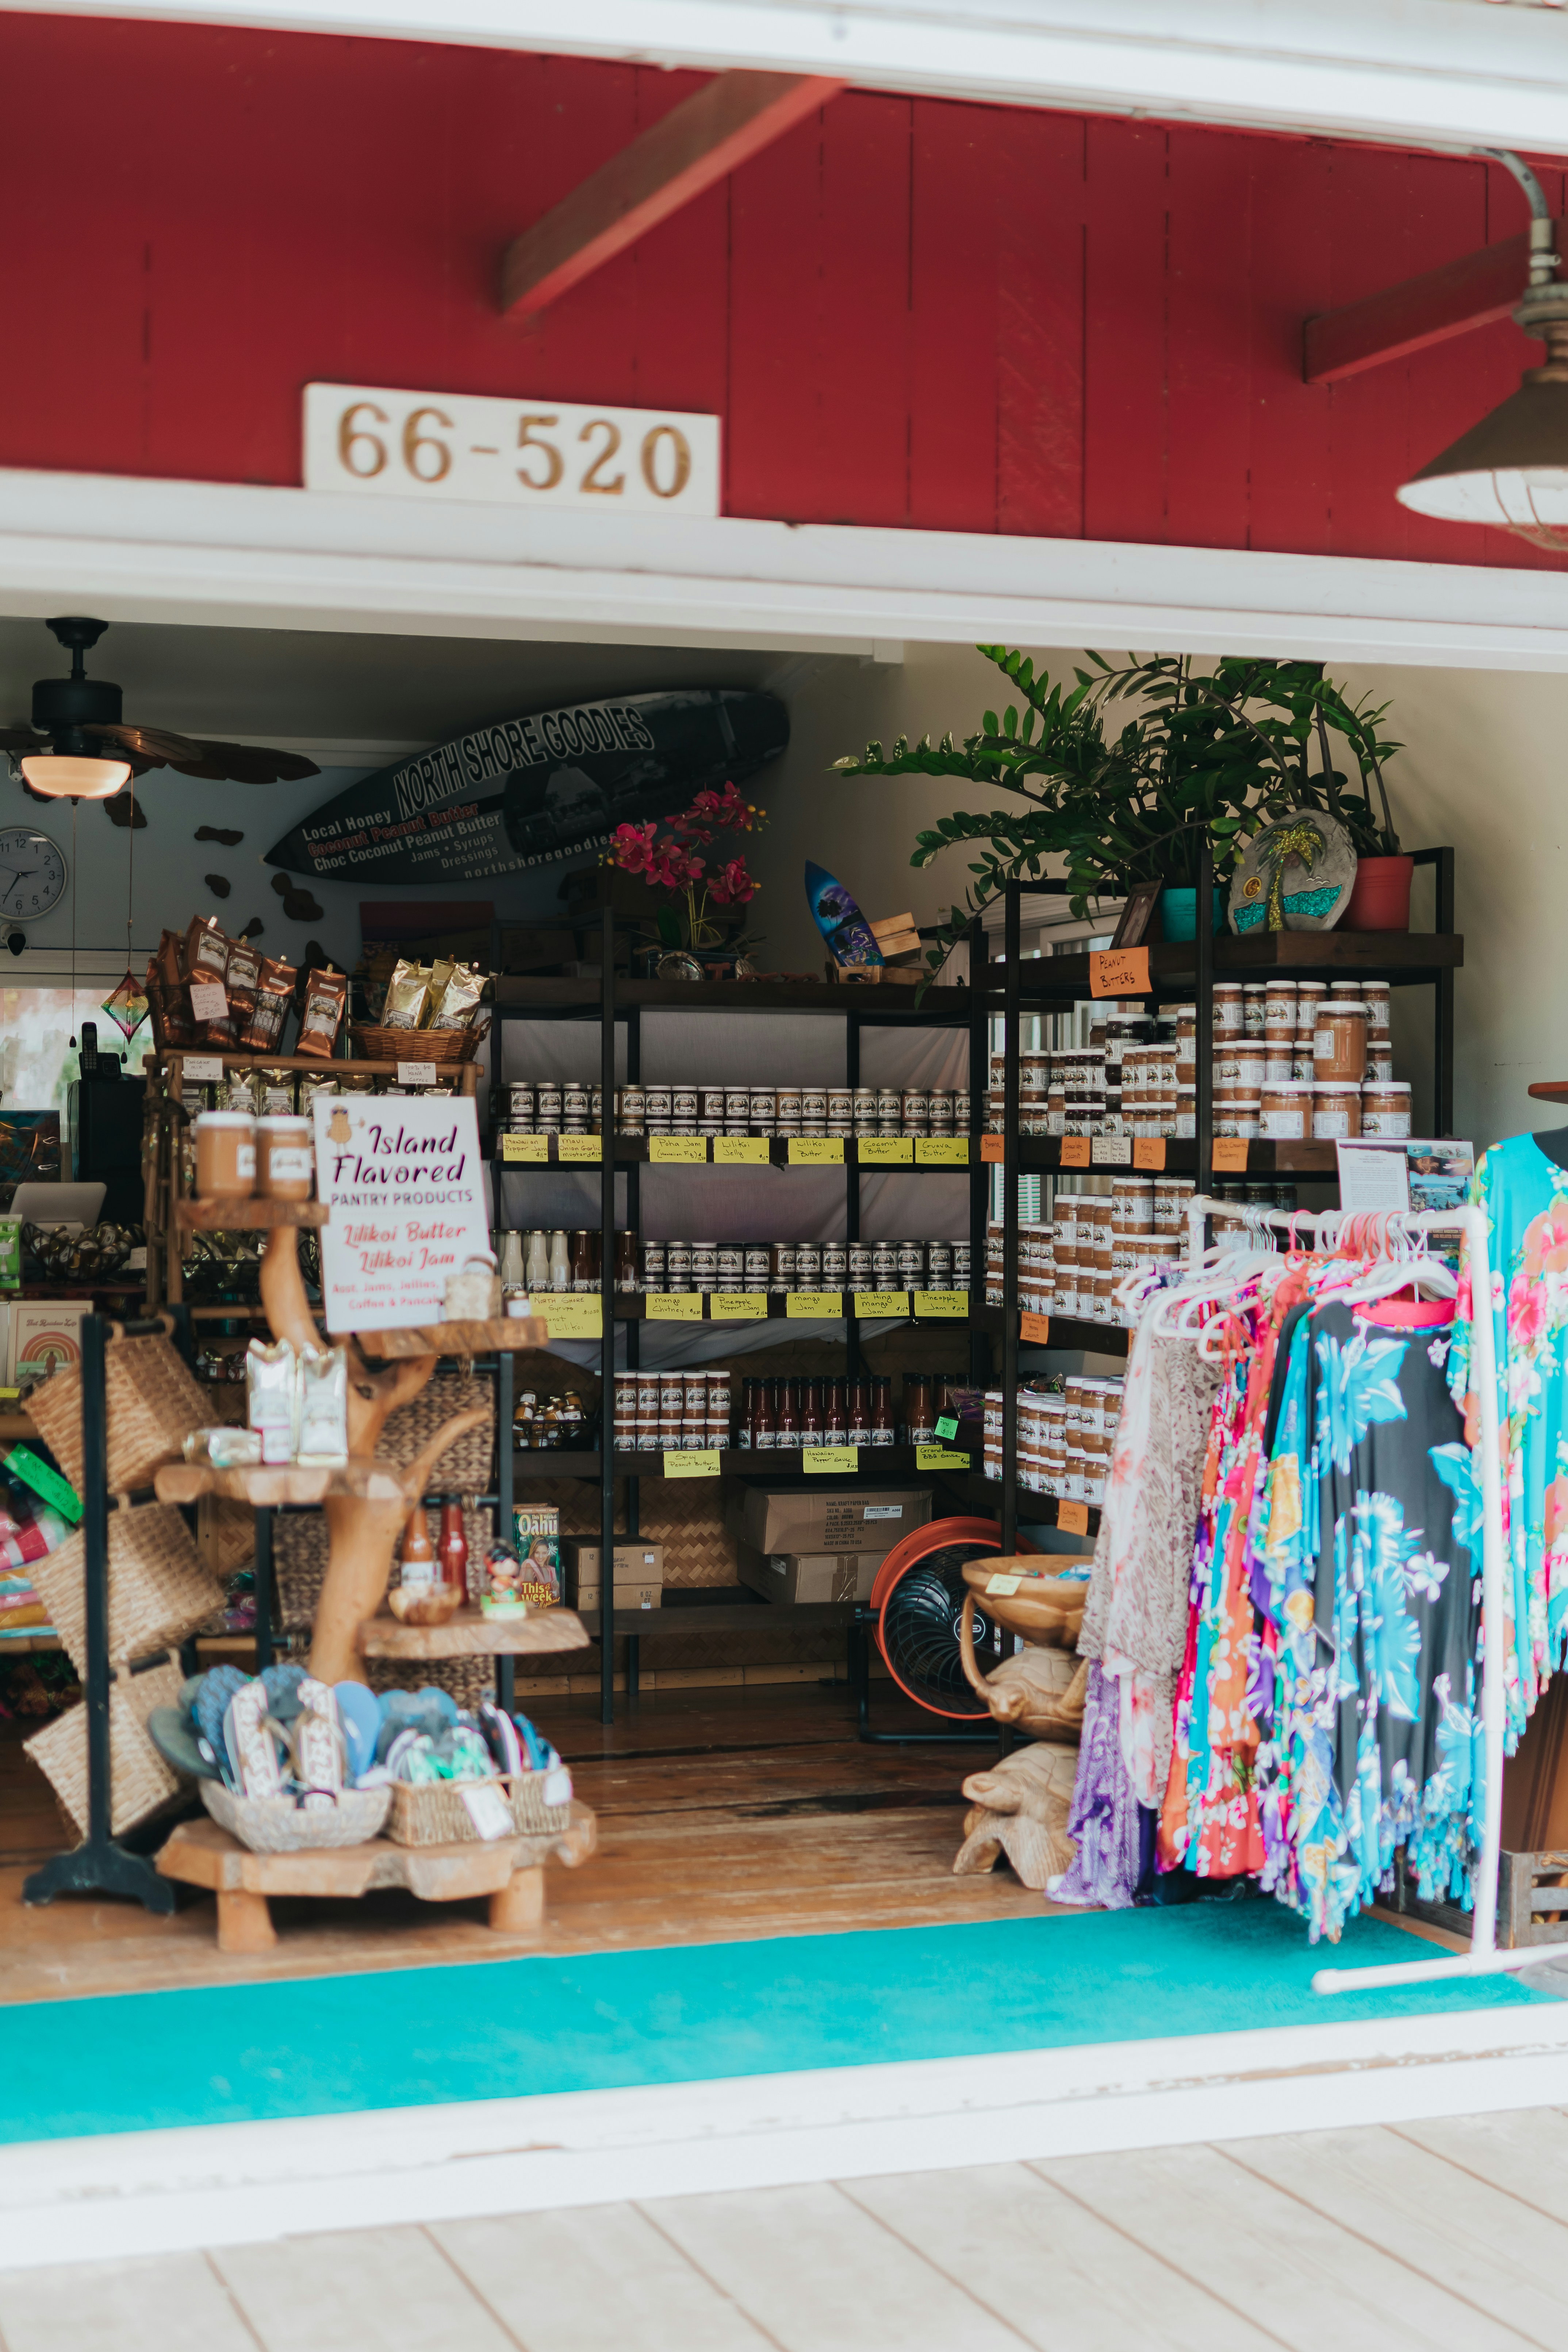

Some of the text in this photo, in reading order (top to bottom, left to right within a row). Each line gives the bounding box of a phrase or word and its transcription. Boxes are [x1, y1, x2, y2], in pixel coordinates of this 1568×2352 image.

[338, 402, 691, 499] 66-520
[393, 706, 655, 821] NORTH SHORE GOODIES
[302, 810, 391, 841] Local Honey
[307, 802, 479, 858] Coconut Peanut Butter
[0, 843, 9, 852] 11
[15, 839, 26, 848] 12
[34, 844, 38, 854] 1
[314, 814, 501, 872] Choc Coconut Peanut Butter
[411, 833, 494, 863] Jams Syrups
[44, 855, 50, 865] 2
[441, 847, 499, 869] Dressings
[49, 870, 55, 880] 3
[43, 886, 49, 895] 4
[1, 895, 8, 904] 7
[16, 900, 22, 909] 6
[32, 896, 38, 905] 5
[1099, 955, 1126, 970] PEANUT
[1100, 972, 1135, 988] BUTTERS
[368, 1124, 458, 1155] Island
[657, 1138, 701, 1147] Poha Jam
[723, 1150, 744, 1158] Jelly
[331, 1153, 465, 1184] Flavored
[331, 1189, 473, 1206] PANTRY PRODUCTS
[344, 1221, 467, 1249] Lilikoi Butter
[359, 1248, 454, 1275] Lilikoi Jam
[534, 1294, 556, 1304] NORTH
[675, 1453, 696, 1463] Spicy
[518, 1514, 557, 1536] Oahu
[522, 1582, 545, 1594] This
